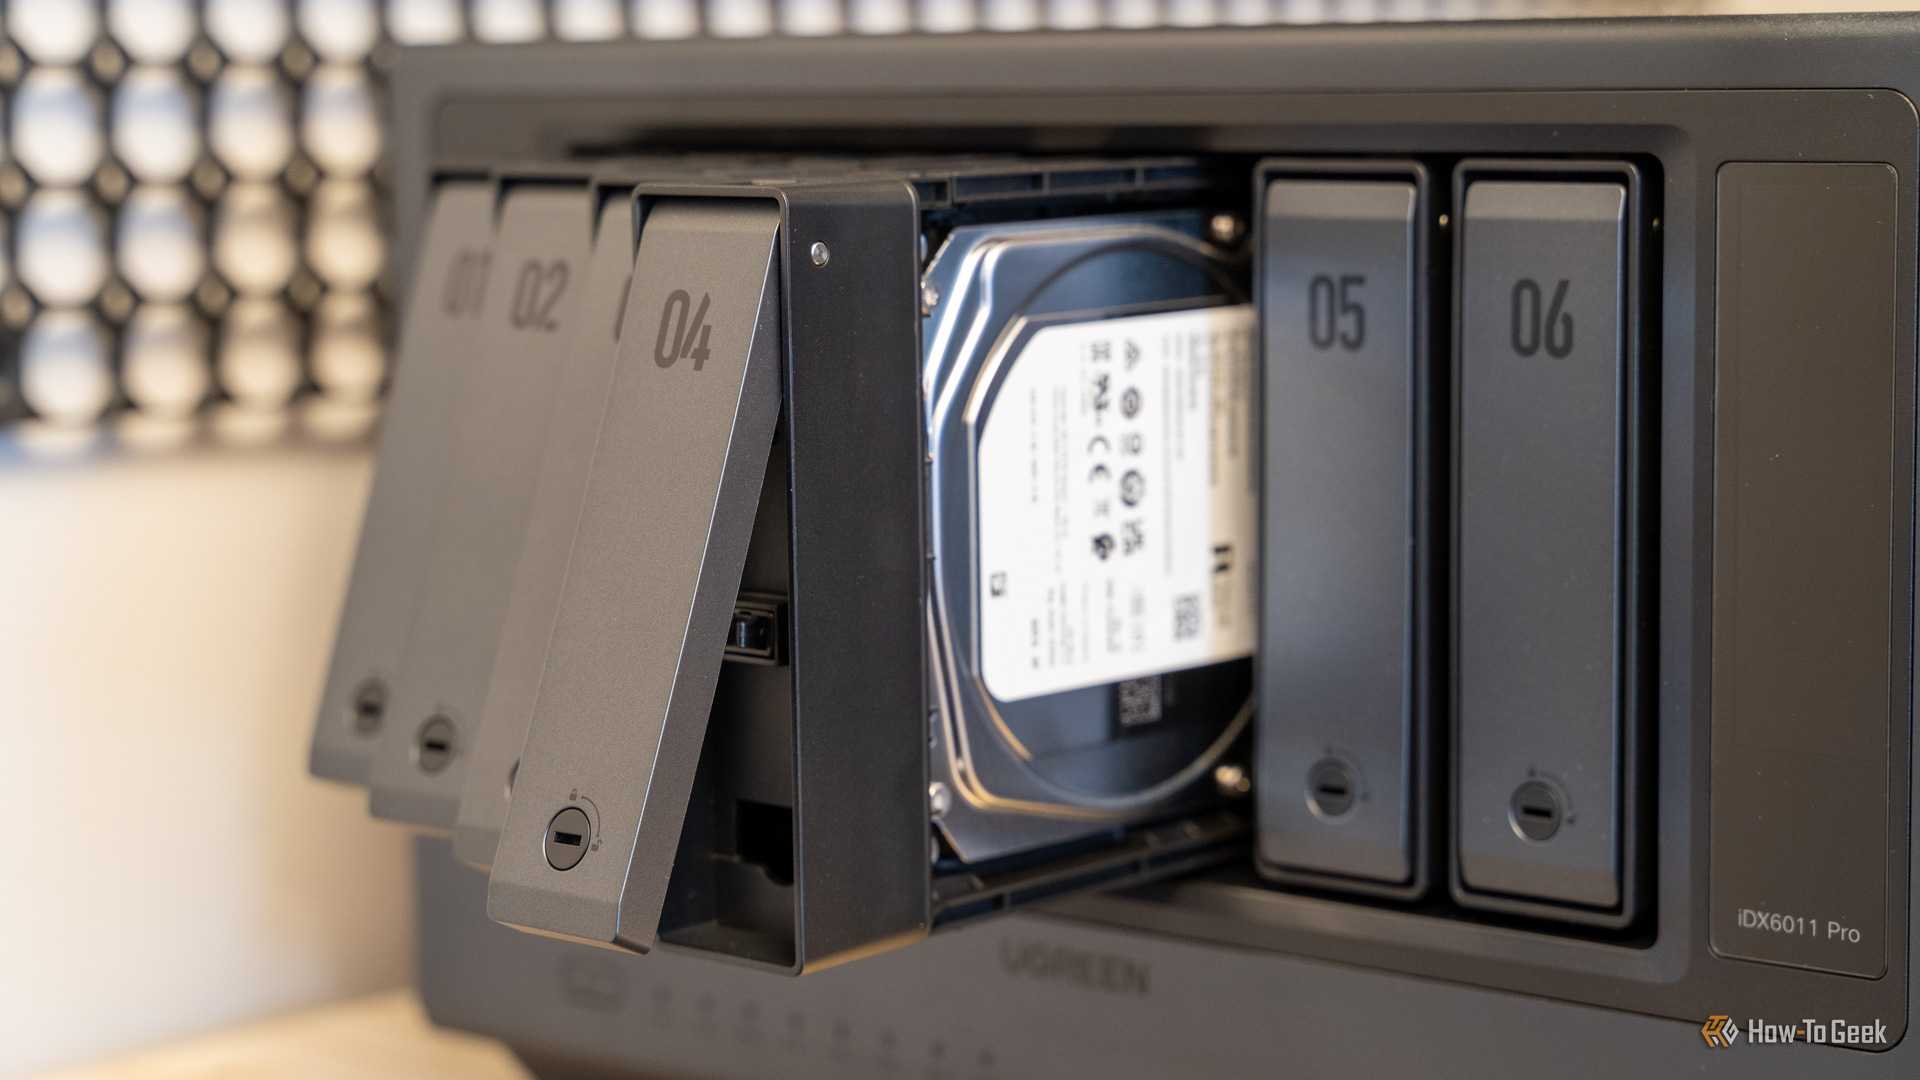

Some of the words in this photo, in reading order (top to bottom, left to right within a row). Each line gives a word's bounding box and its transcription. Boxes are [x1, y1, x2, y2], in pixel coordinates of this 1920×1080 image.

[509, 258, 570, 331] 02
[654, 288, 712, 371] 04
[1308, 274, 1366, 350] 05
[1511, 277, 1575, 359] 06
[1737, 908, 1817, 936] iDX6011
[1827, 920, 1861, 943] Pro
[1000, 937, 1151, 996] UGREEN
